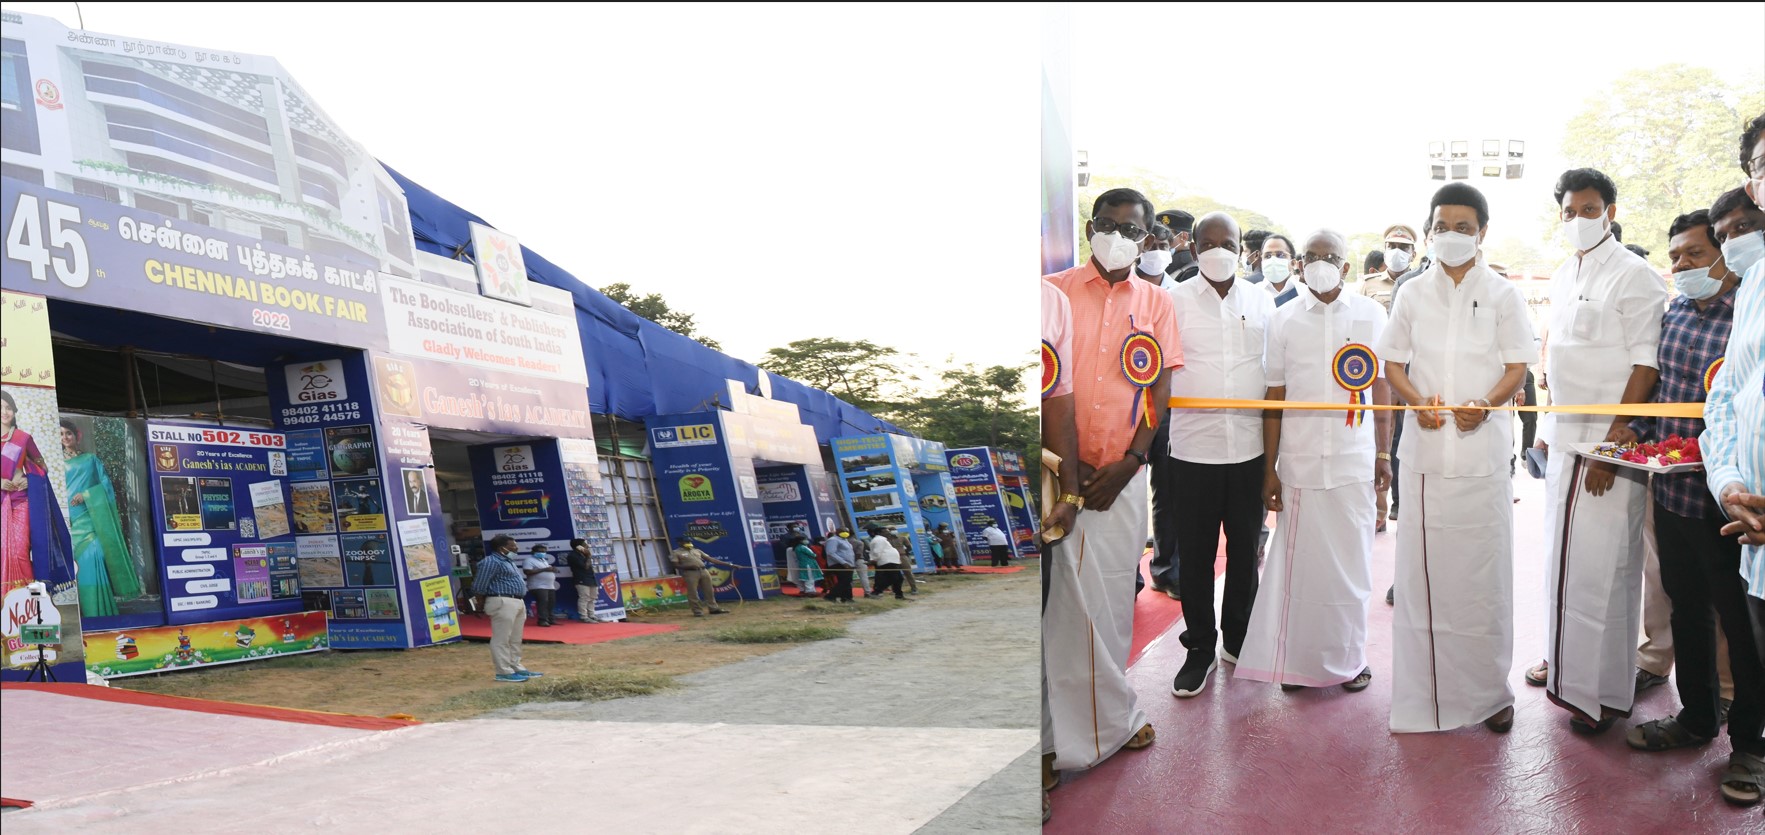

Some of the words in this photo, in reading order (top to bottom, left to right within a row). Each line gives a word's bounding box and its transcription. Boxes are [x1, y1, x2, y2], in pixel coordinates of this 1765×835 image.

[6, 193, 90, 288] 45
[118, 216, 229, 261] சென்னை
[236, 242, 319, 280] புத்தகக்
[324, 265, 378, 294] காட்சி
[95, 268, 106, 278] th
[144, 259, 258, 302] CHENNAI
[260, 282, 322, 315] BOOK
[324, 295, 369, 324] FAIR
[389, 286, 417, 307] The
[500, 313, 508, 326] &
[253, 309, 290, 329] 2022
[407, 311, 483, 340] Association
[486, 328, 498, 342] of
[500, 331, 532, 350] South
[534, 337, 563, 355] India
[423, 339, 461, 360] Gladly
[463, 346, 515, 367] Welcomes
[468, 377, 479, 387] 20
[480, 379, 500, 390] Years
[501, 382, 508, 391] of
[298, 390, 338, 402] Gias
[281, 405, 319, 417] 98402
[321, 402, 360, 412] 41118
[423, 386, 495, 421] Ganesh's
[525, 405, 586, 428] ACADEMY
[283, 414, 320, 425] 99402
[323, 411, 361, 421] 44576
[151, 430, 184, 441] STALL
[188, 433, 202, 442] NO
[202, 430, 245, 445] 502,
[249, 433, 284, 447] 503
[391, 426, 402, 437] 20
[403, 428, 421, 438] Years
[680, 426, 711, 440] LIC
[328, 441, 372, 451] GEOGRAPHY
[836, 435, 885, 445] HIGH-TECH
[838, 443, 887, 452] AMENITIES
[182, 458, 219, 470] Ganesh's
[220, 460, 233, 470] ias
[235, 463, 267, 471] ACADEMY
[502, 463, 529, 472] Gias
[959, 457, 971, 466] IAS
[202, 493, 229, 501] PHYSICS
[683, 490, 711, 498] AROGYA
[504, 498, 538, 506] Courses
[507, 507, 538, 515] Offered
[8, 598, 39, 634] Nall
